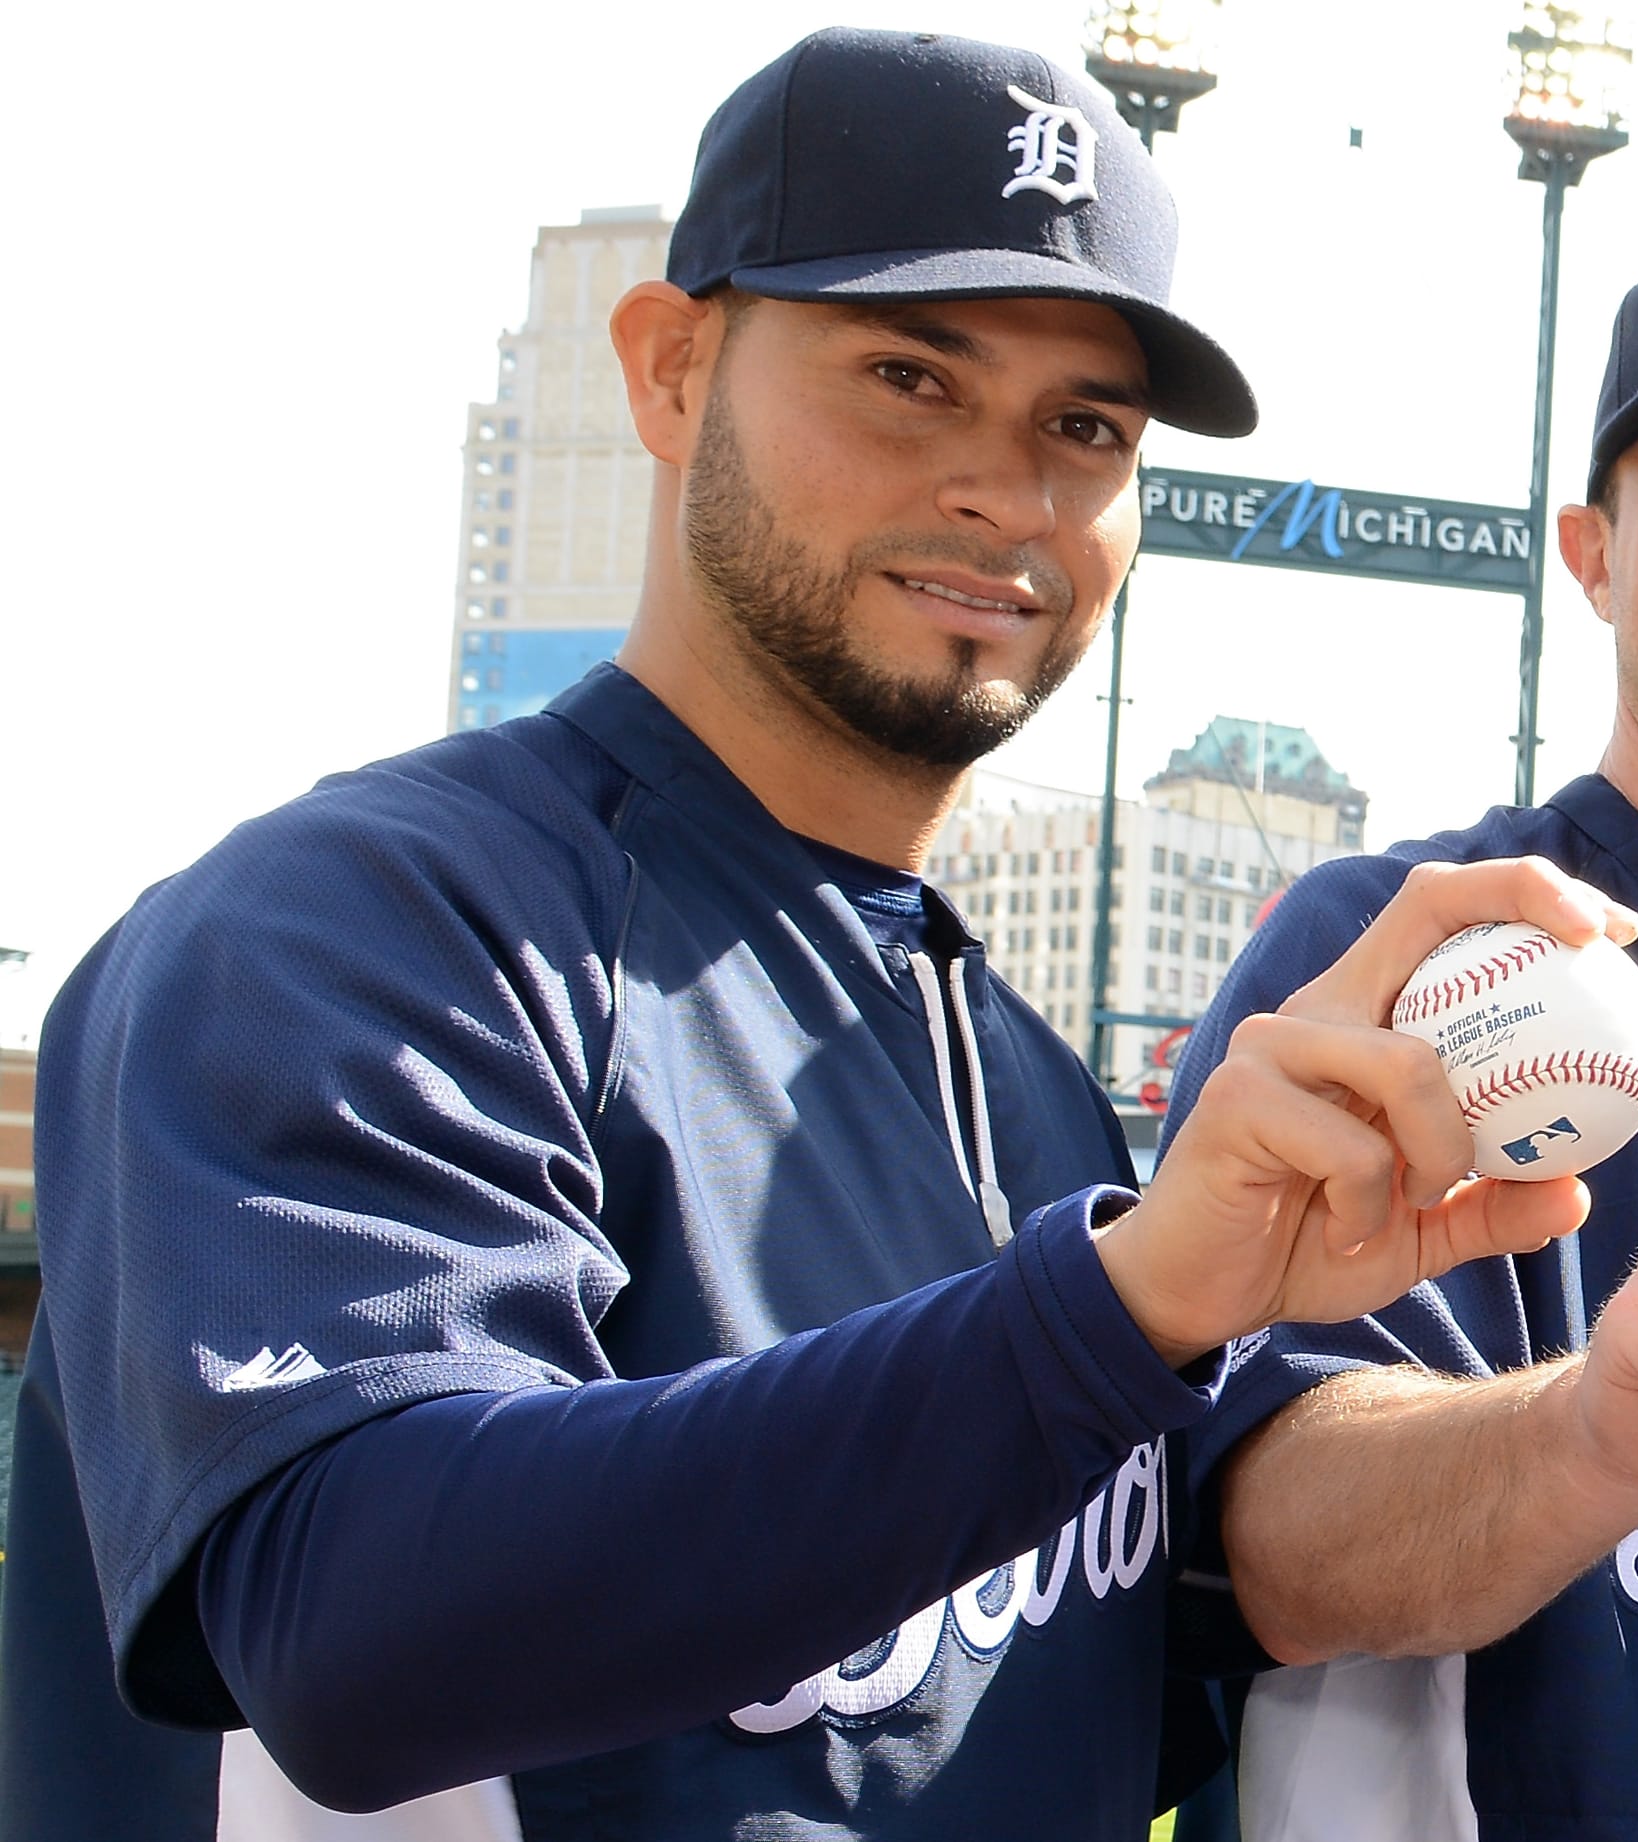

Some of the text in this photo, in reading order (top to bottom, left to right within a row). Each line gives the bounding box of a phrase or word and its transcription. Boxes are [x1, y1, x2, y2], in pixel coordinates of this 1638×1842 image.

[1001, 85, 1099, 205] D
[1142, 479, 1531, 560] PURE MICHIGAN
[1447, 1009, 1488, 1036] OFFICIAL
[1447, 1025, 1484, 1053] LEAGUE
[1485, 1001, 1546, 1034] BASEBALL
